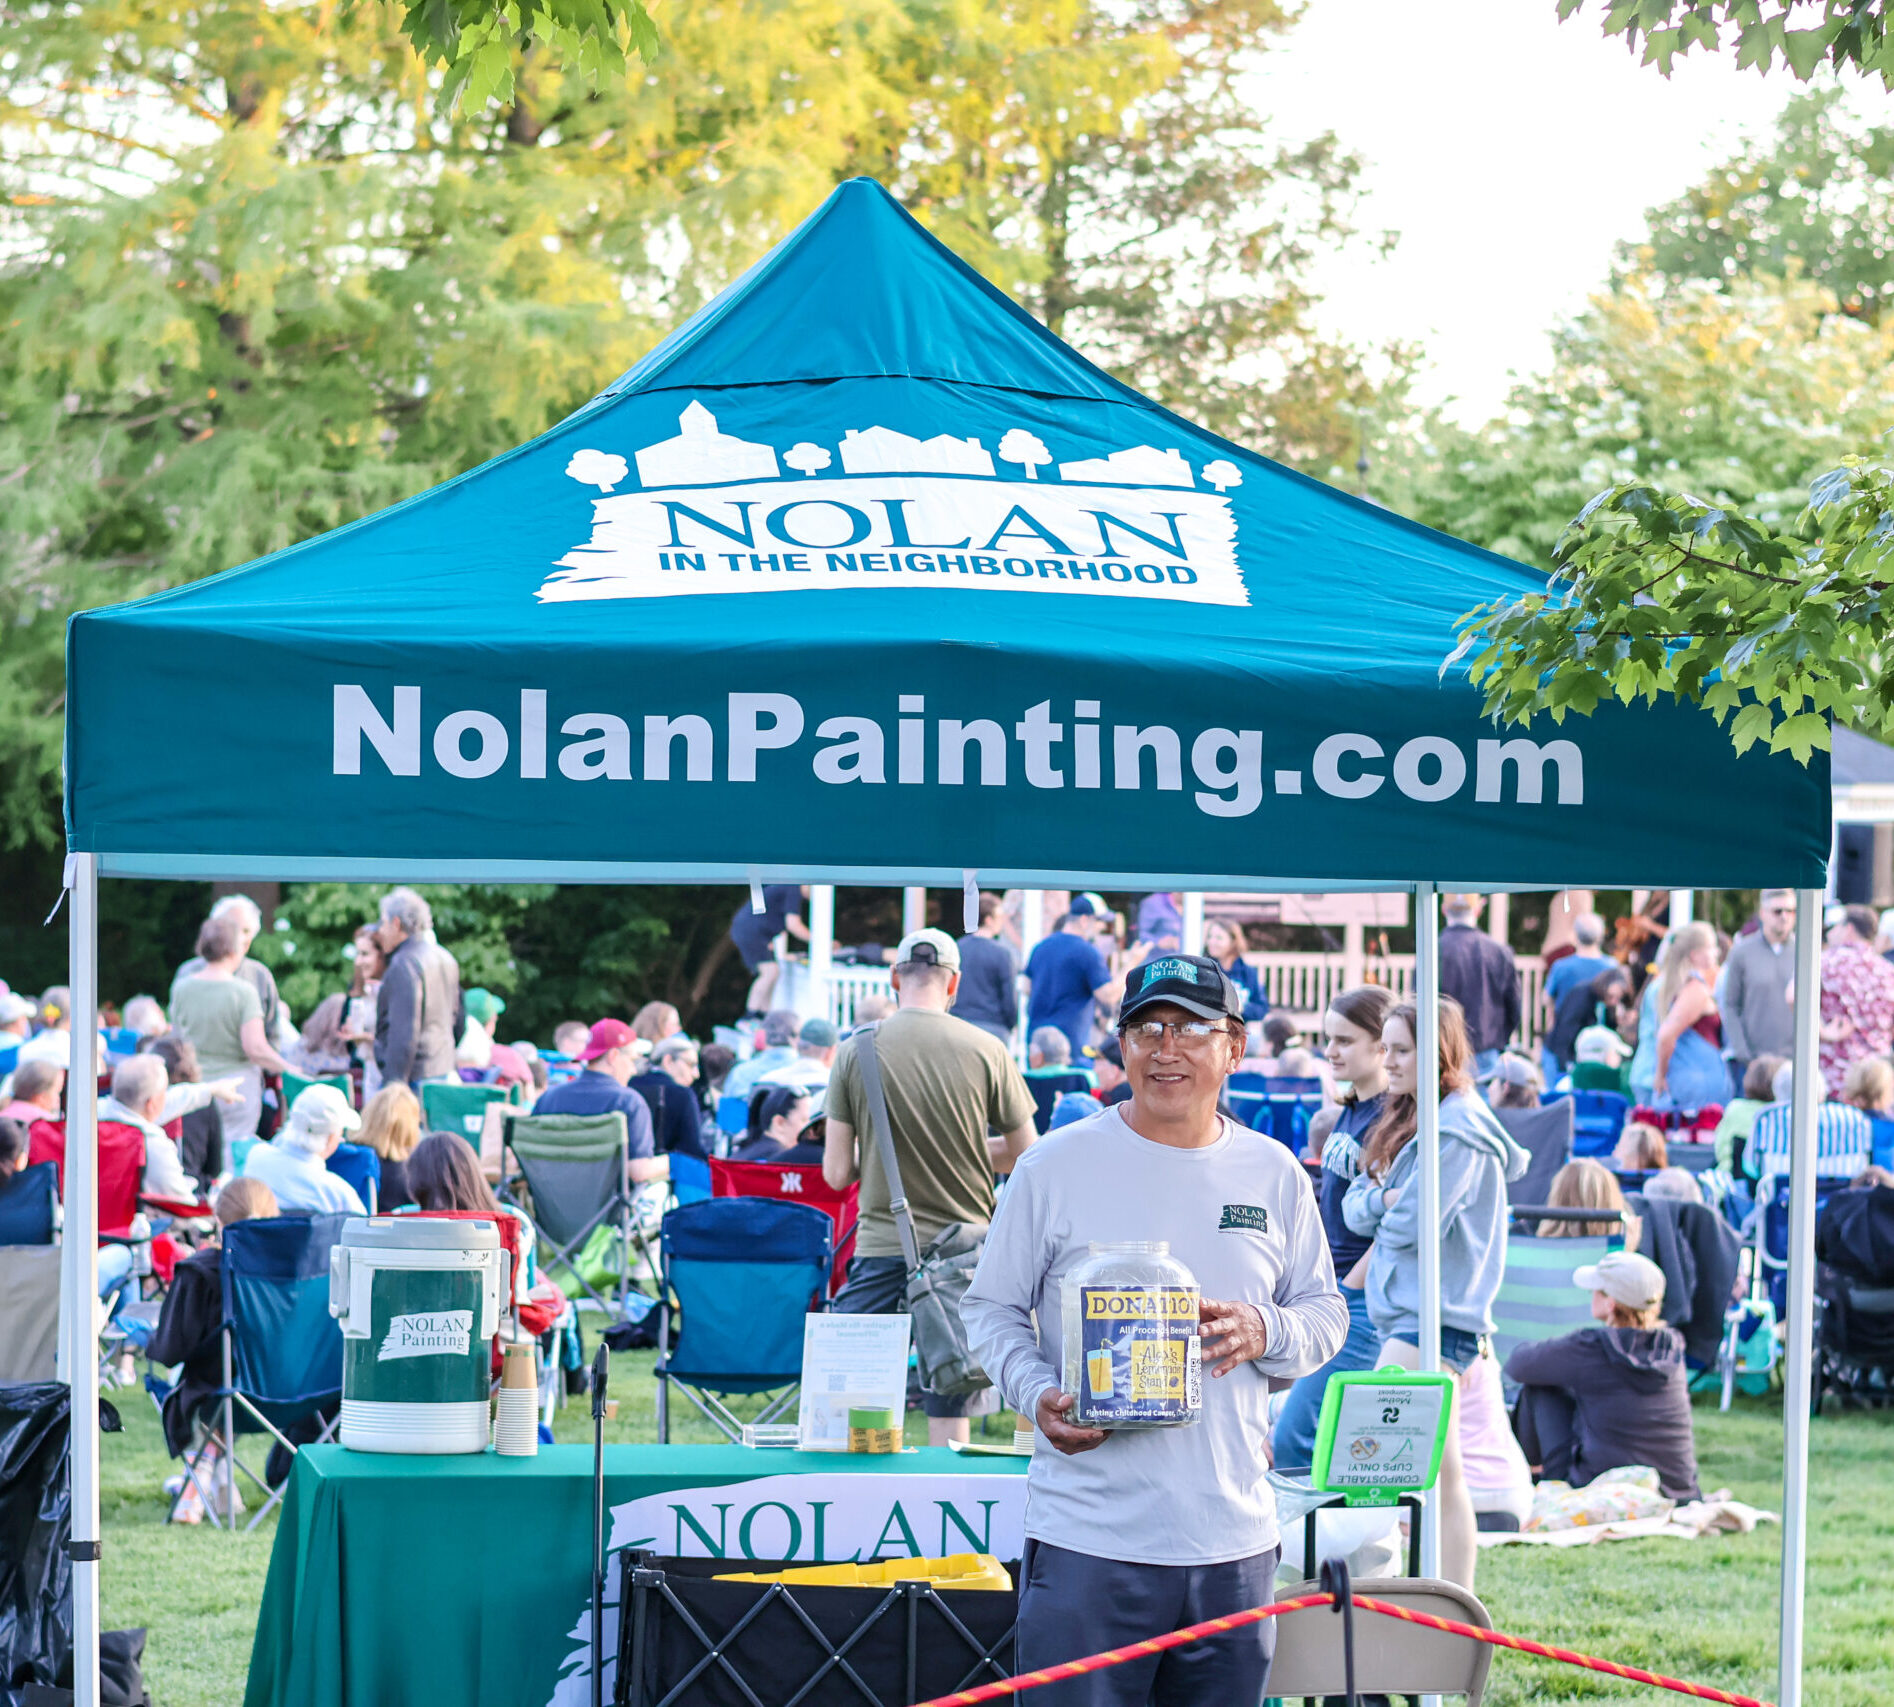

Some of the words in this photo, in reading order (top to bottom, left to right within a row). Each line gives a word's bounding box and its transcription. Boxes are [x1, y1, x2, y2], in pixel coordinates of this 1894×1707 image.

[648, 499, 1196, 562] NOLAN
[659, 552, 703, 572] IN
[718, 552, 808, 574] THE
[827, 553, 1198, 585] NEIGHBORHOOD
[331, 683, 1585, 818] NolanPainting.com
[1151, 960, 1193, 973] NOLAN
[1229, 1205, 1264, 1220] NOLAN
[1230, 1214, 1266, 1231] Painting
[402, 1317, 465, 1332] NOLAN
[1119, 1326, 1131, 1334] All
[1133, 1326, 1169, 1335] Proceeds
[1170, 1326, 1192, 1335] Benefit
[402, 1333, 465, 1349] Painting
[1377, 1397, 1411, 1405] Mother
[1086, 1409, 1114, 1418] Fighting
[1115, 1409, 1152, 1417] Childhood
[1348, 1463, 1380, 1472] ONLY!
[1383, 1463, 1413, 1472] CUPS
[1337, 1475, 1419, 1484] COMPOSTABLE
[667, 1499, 999, 1562] NOLAN
